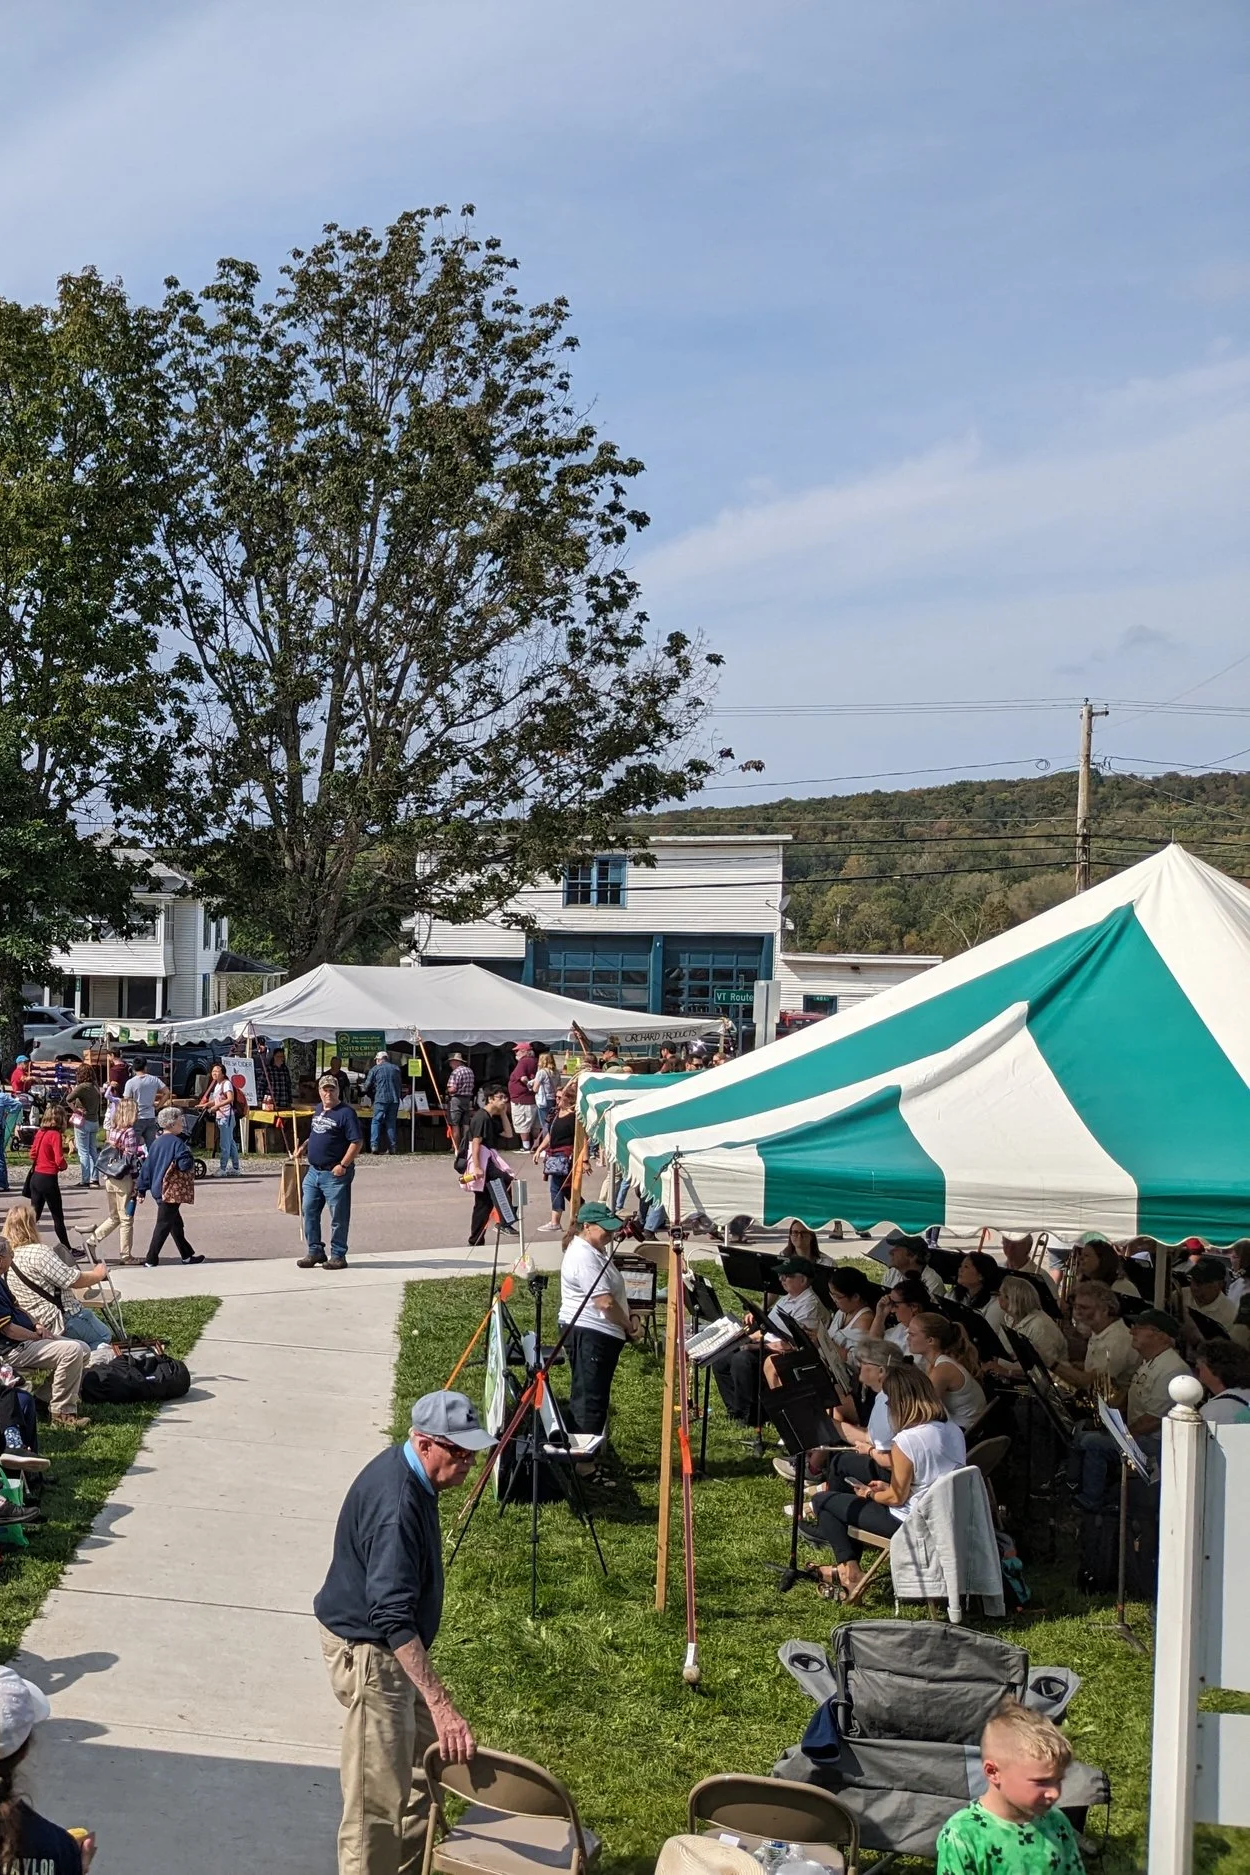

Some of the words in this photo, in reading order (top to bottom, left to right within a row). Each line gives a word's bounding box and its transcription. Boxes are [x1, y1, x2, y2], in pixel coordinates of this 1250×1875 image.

[716, 992, 727, 1001] VT
[730, 992, 754, 1002] Route
[625, 1032, 660, 1042] ORCHARD
[662, 1029, 697, 1040] PRODUCTS
